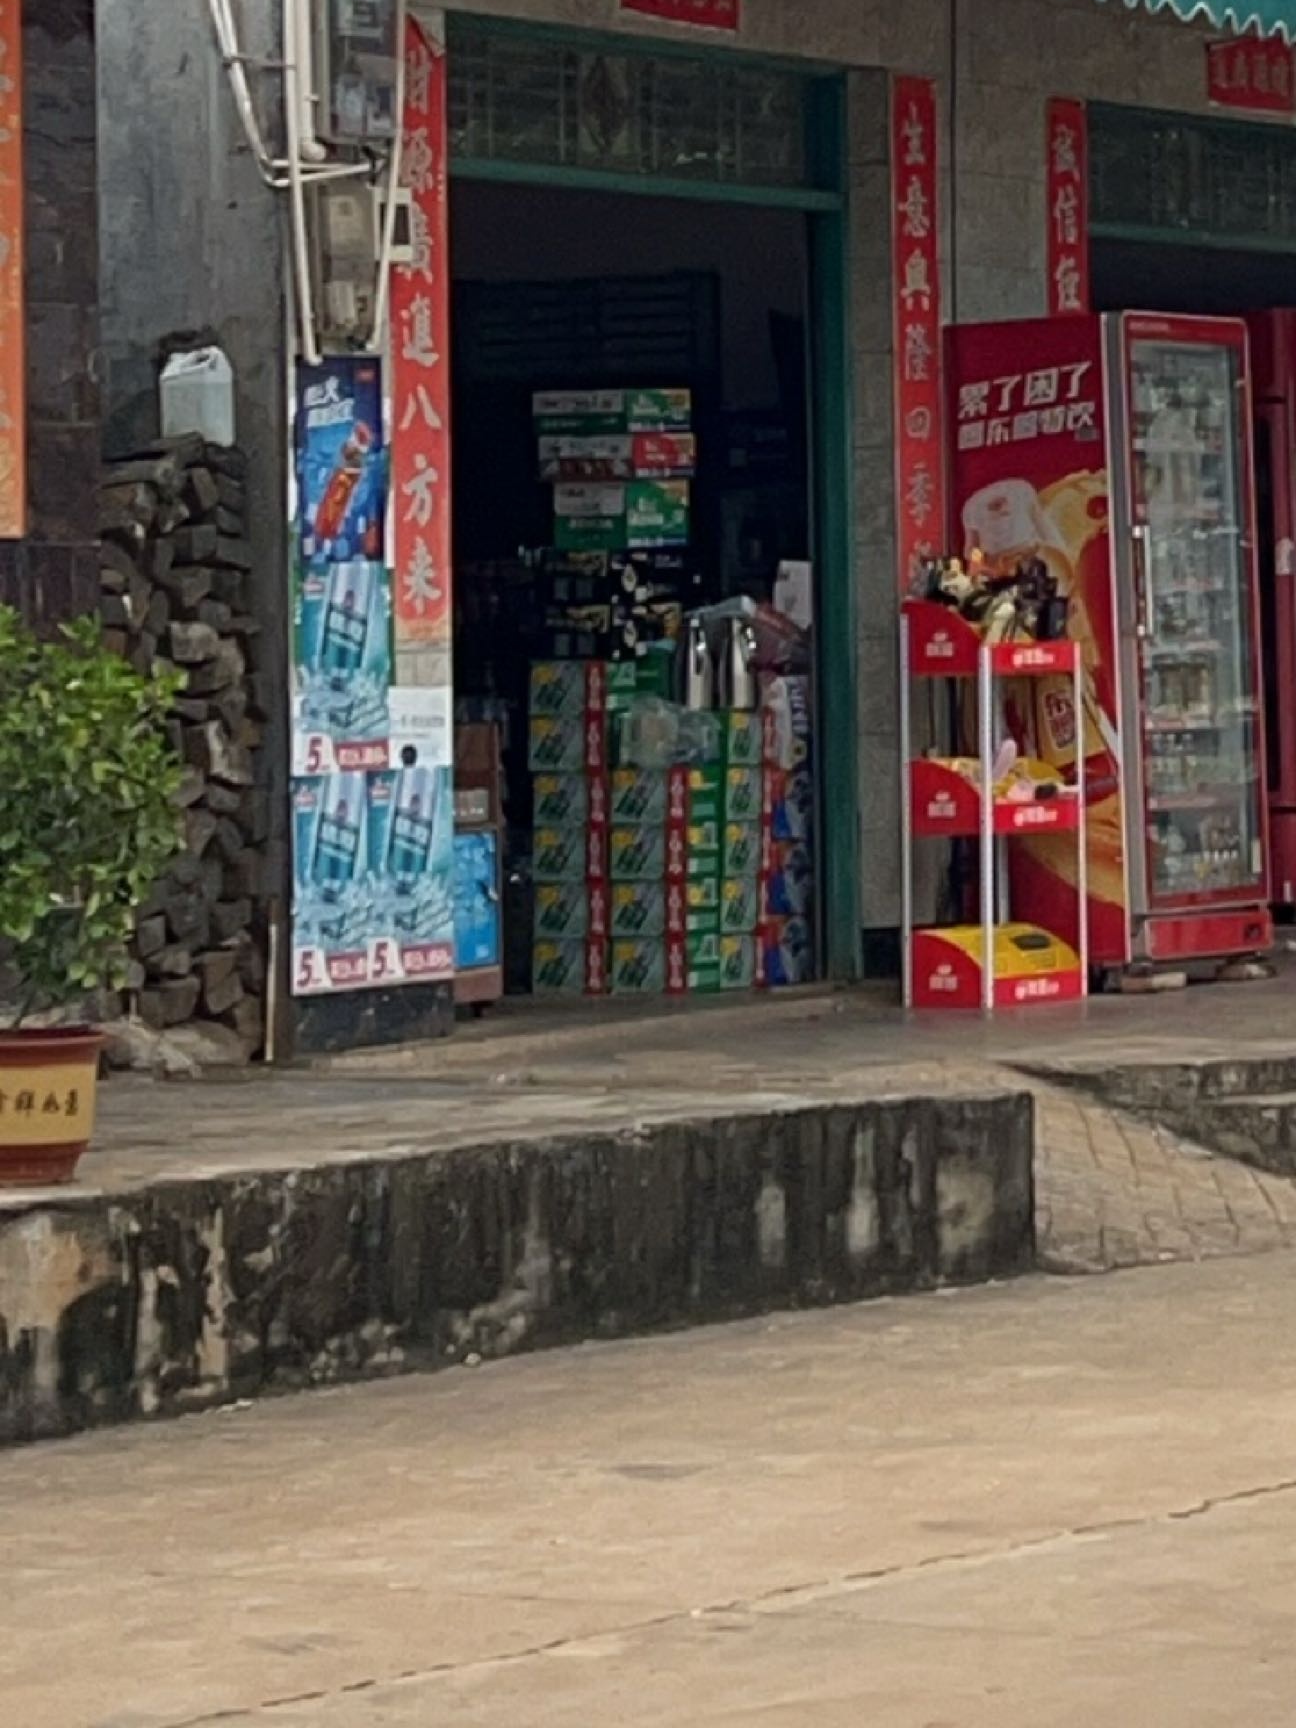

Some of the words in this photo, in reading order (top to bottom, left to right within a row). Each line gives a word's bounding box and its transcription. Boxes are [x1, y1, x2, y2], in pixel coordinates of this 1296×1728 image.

[957, 360, 1093, 421] 累了困了
[306, 737, 324, 772] 5
[297, 950, 314, 986] 5
[372, 942, 389, 978] 5
